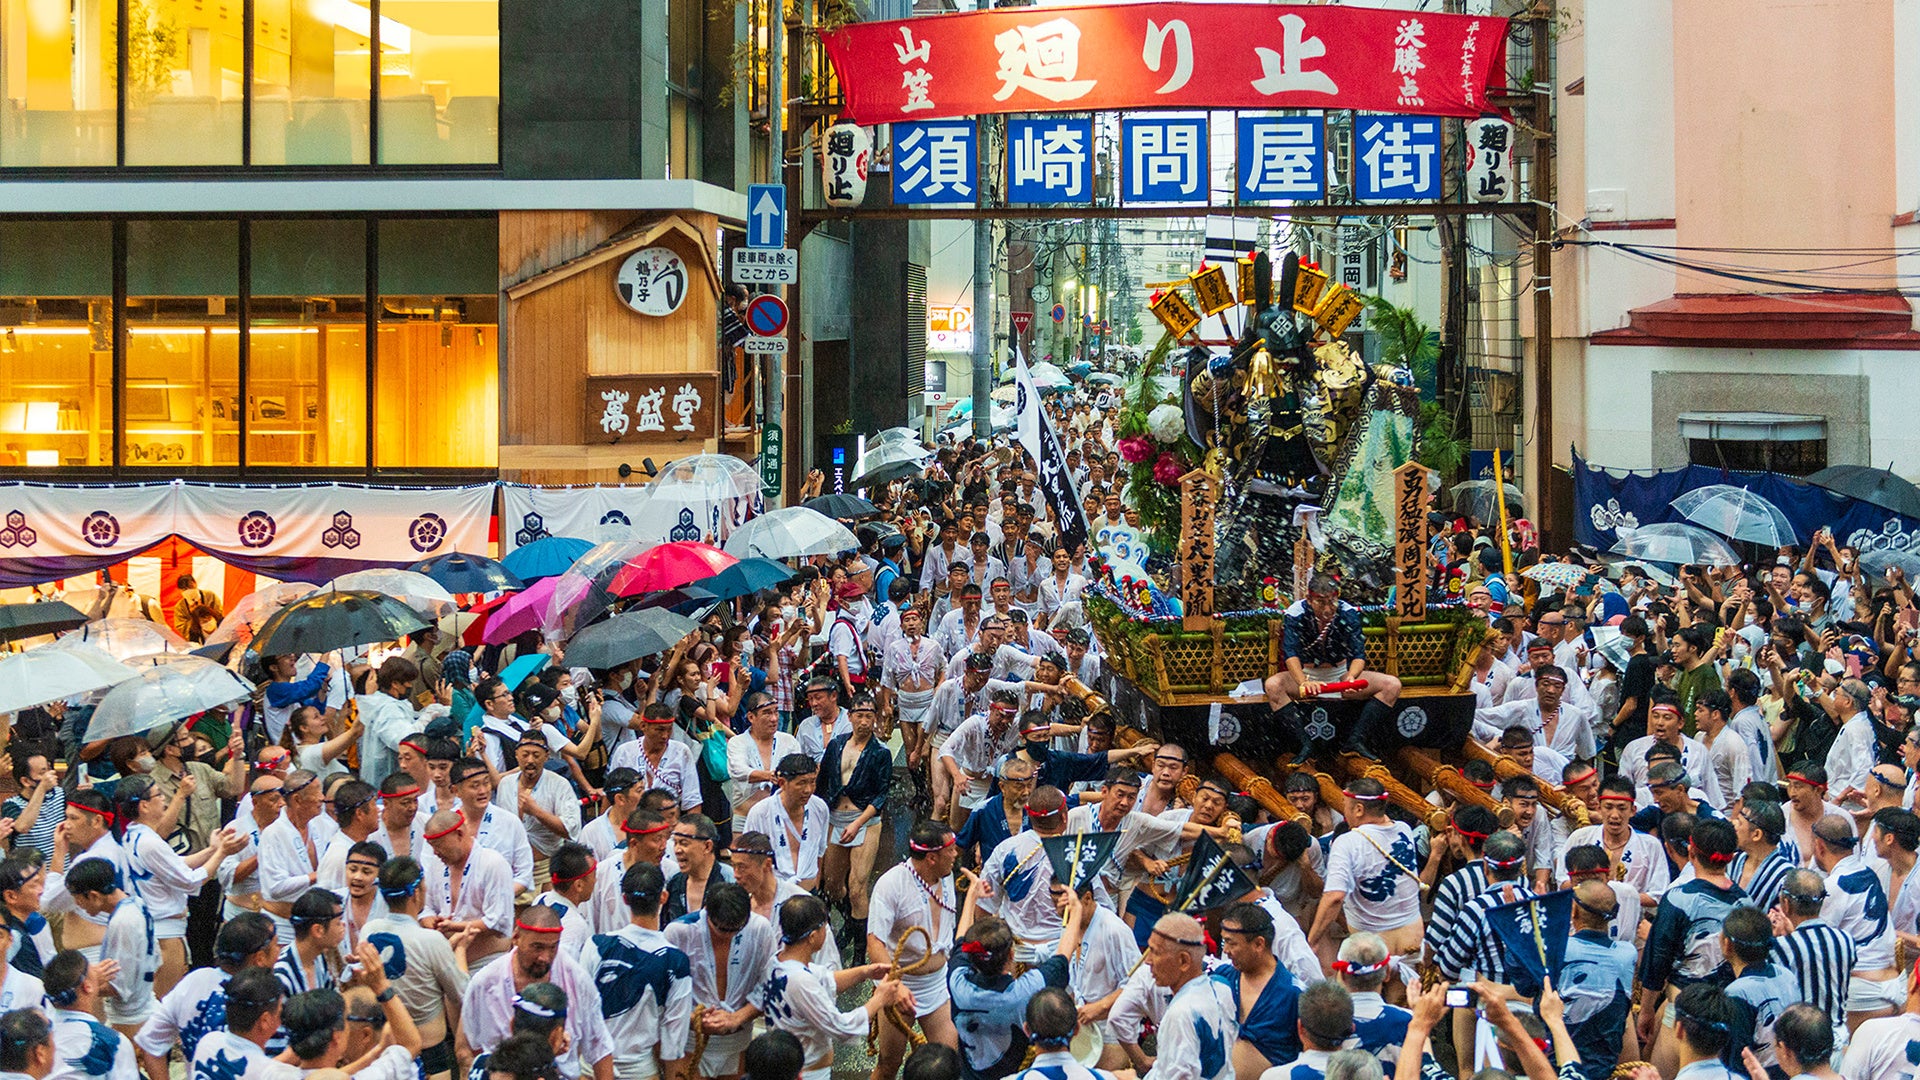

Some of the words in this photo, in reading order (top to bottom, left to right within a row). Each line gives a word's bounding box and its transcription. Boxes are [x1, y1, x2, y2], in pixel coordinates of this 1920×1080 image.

[895, 26, 935, 114] 山笠
[992, 14, 1339, 103] 廻り止
[1394, 18, 1427, 108] 決勝点
[1460, 21, 1481, 105] 平成七年七月
[826, 125, 854, 201] 廻り止
[899, 122, 1441, 197] 須崎問屋街
[1477, 118, 1506, 200] 廻り止
[635, 260, 651, 303] 鶴乃子
[737, 251, 793, 265] 軽車両を除く
[740, 268, 790, 281] ここから
[747, 340, 786, 352] ここから
[600, 383, 702, 436] 萬盛堂
[767, 429, 779, 484] 須崎通り
